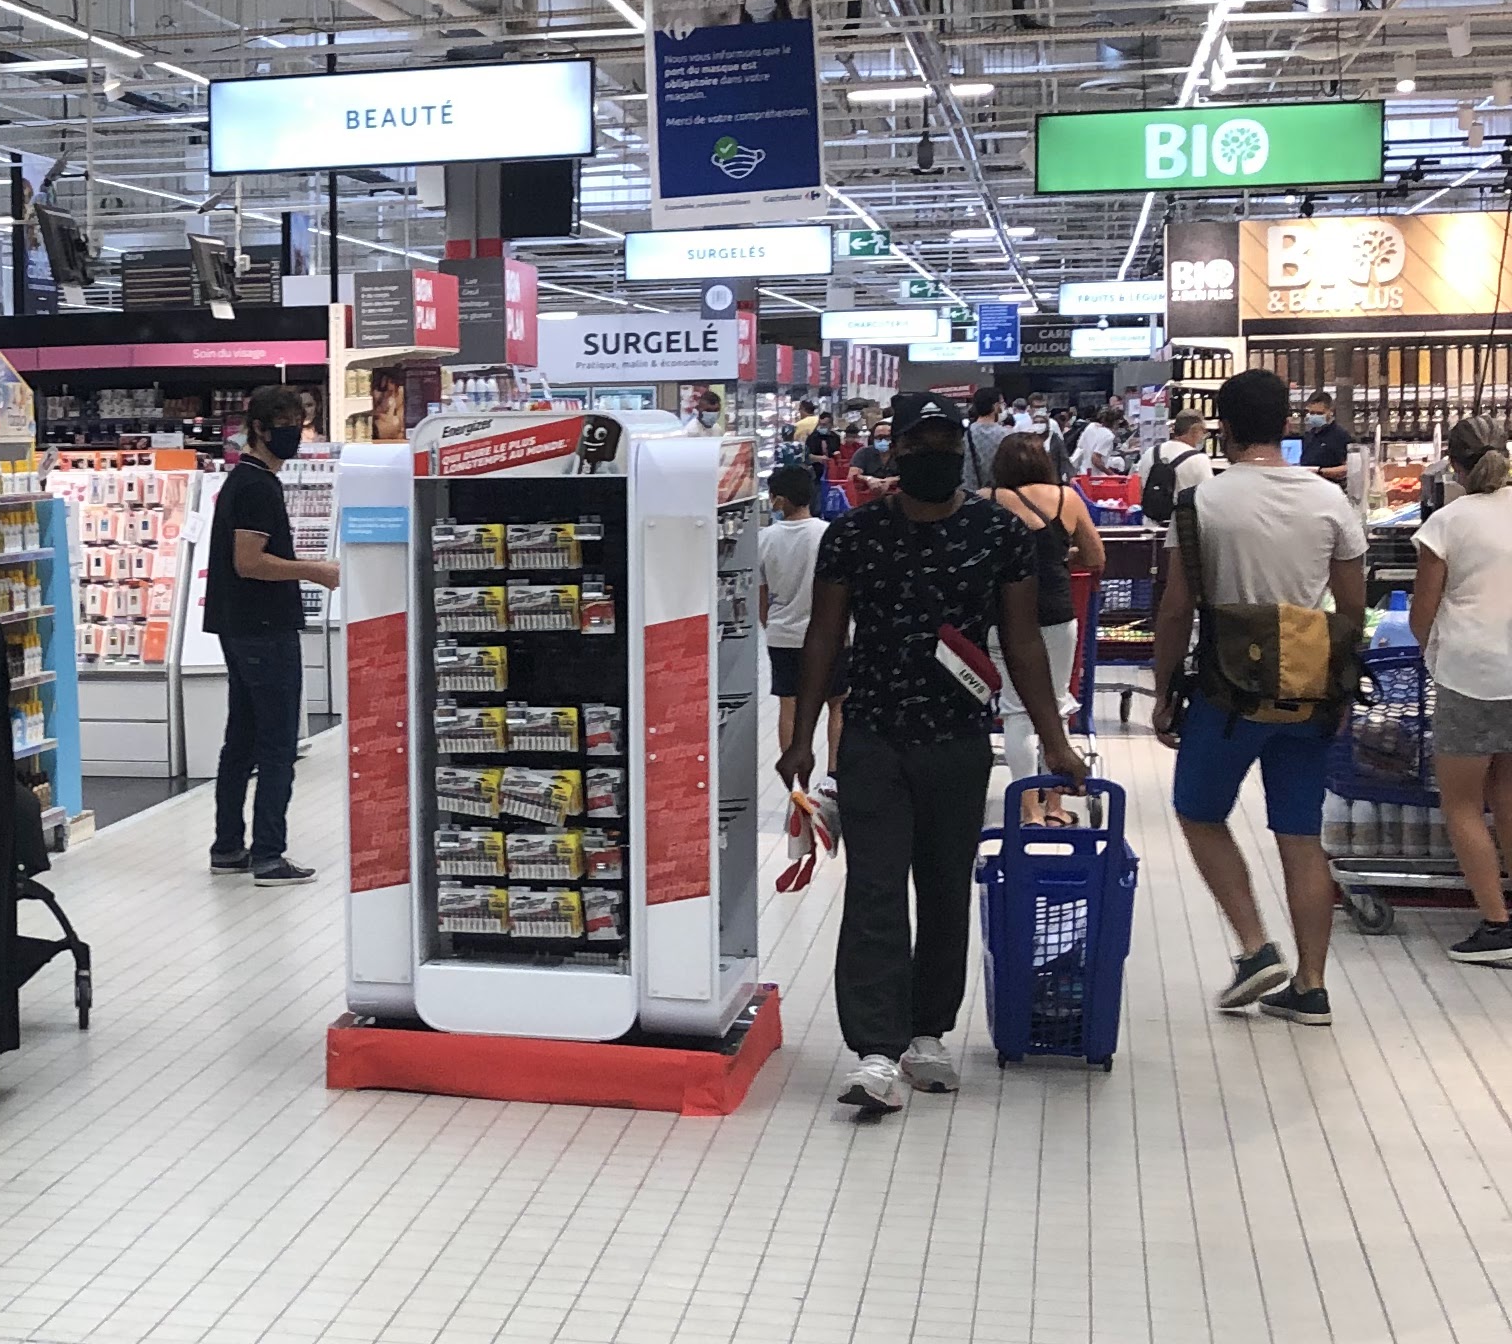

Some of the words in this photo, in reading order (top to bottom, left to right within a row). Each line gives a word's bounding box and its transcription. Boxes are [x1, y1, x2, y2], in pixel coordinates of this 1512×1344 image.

[686, 65, 700, 75] du
[701, 63, 740, 73] masque
[741, 61, 758, 70] est
[664, 77, 719, 89] obligatoire
[720, 75, 743, 85] dans
[346, 99, 453, 130] BEAUTÉ
[665, 116, 693, 127] Merci
[694, 114, 706, 125] de
[707, 114, 734, 124] votre
[1145, 118, 1270, 179] BIO
[687, 245, 766, 260] SURGELÉS
[1267, 220, 1406, 288] BO
[1171, 258, 1235, 291] BIO
[1078, 294, 1115, 303] FRUITS
[1267, 291, 1286, 312] &
[583, 323, 719, 356] SURGELÉ
[192, 348, 216, 359] Soin
[218, 348, 231, 358] du
[233, 348, 266, 360] visage
[575, 361, 619, 371] Pratique,
[651, 359, 657, 368] &
[660, 358, 719, 368] économique
[442, 419, 493, 439] Energizer
[441, 454, 462, 466] QUI
[462, 447, 492, 461] DURE
[493, 443, 506, 454] LE
[507, 436, 537, 451] PLUS
[442, 453, 507, 475] LONGTEMPS
[508, 449, 525, 460] AU
